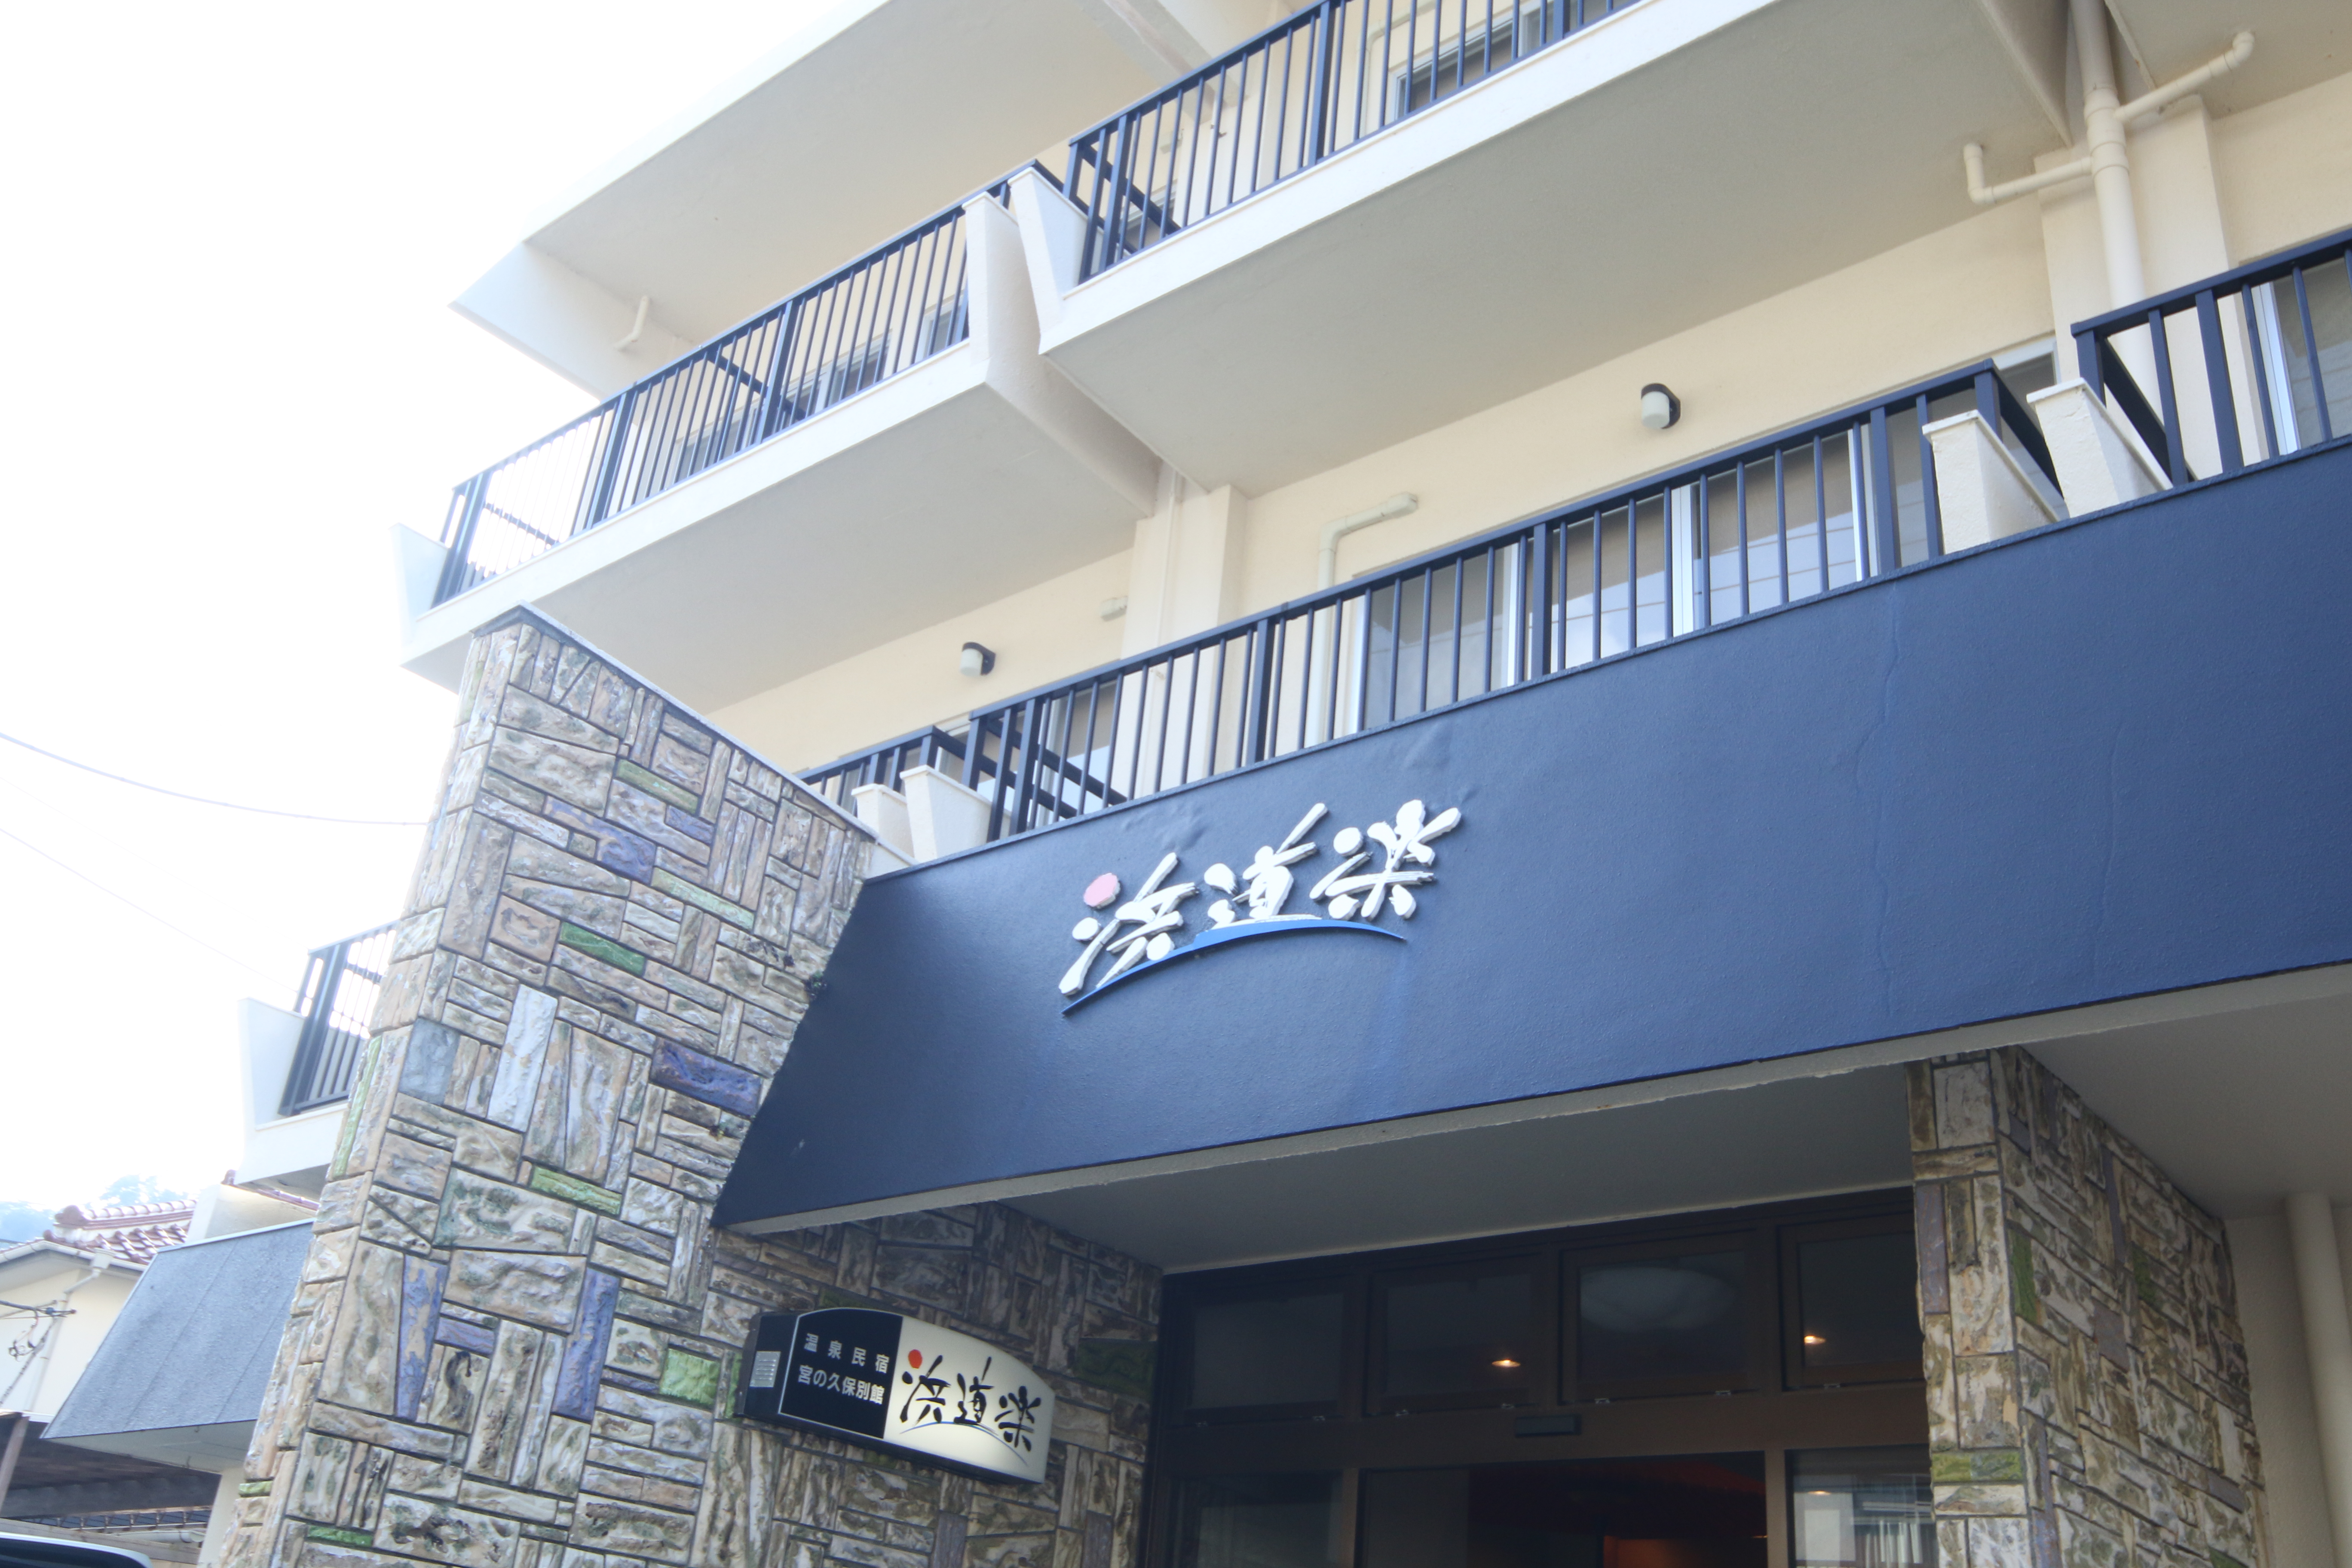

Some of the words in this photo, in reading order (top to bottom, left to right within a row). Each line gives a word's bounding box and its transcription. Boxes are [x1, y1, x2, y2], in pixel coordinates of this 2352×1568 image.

[803, 1332, 890, 1374] 温泉民宿
[797, 1364, 885, 1405] 宮の久保別館
